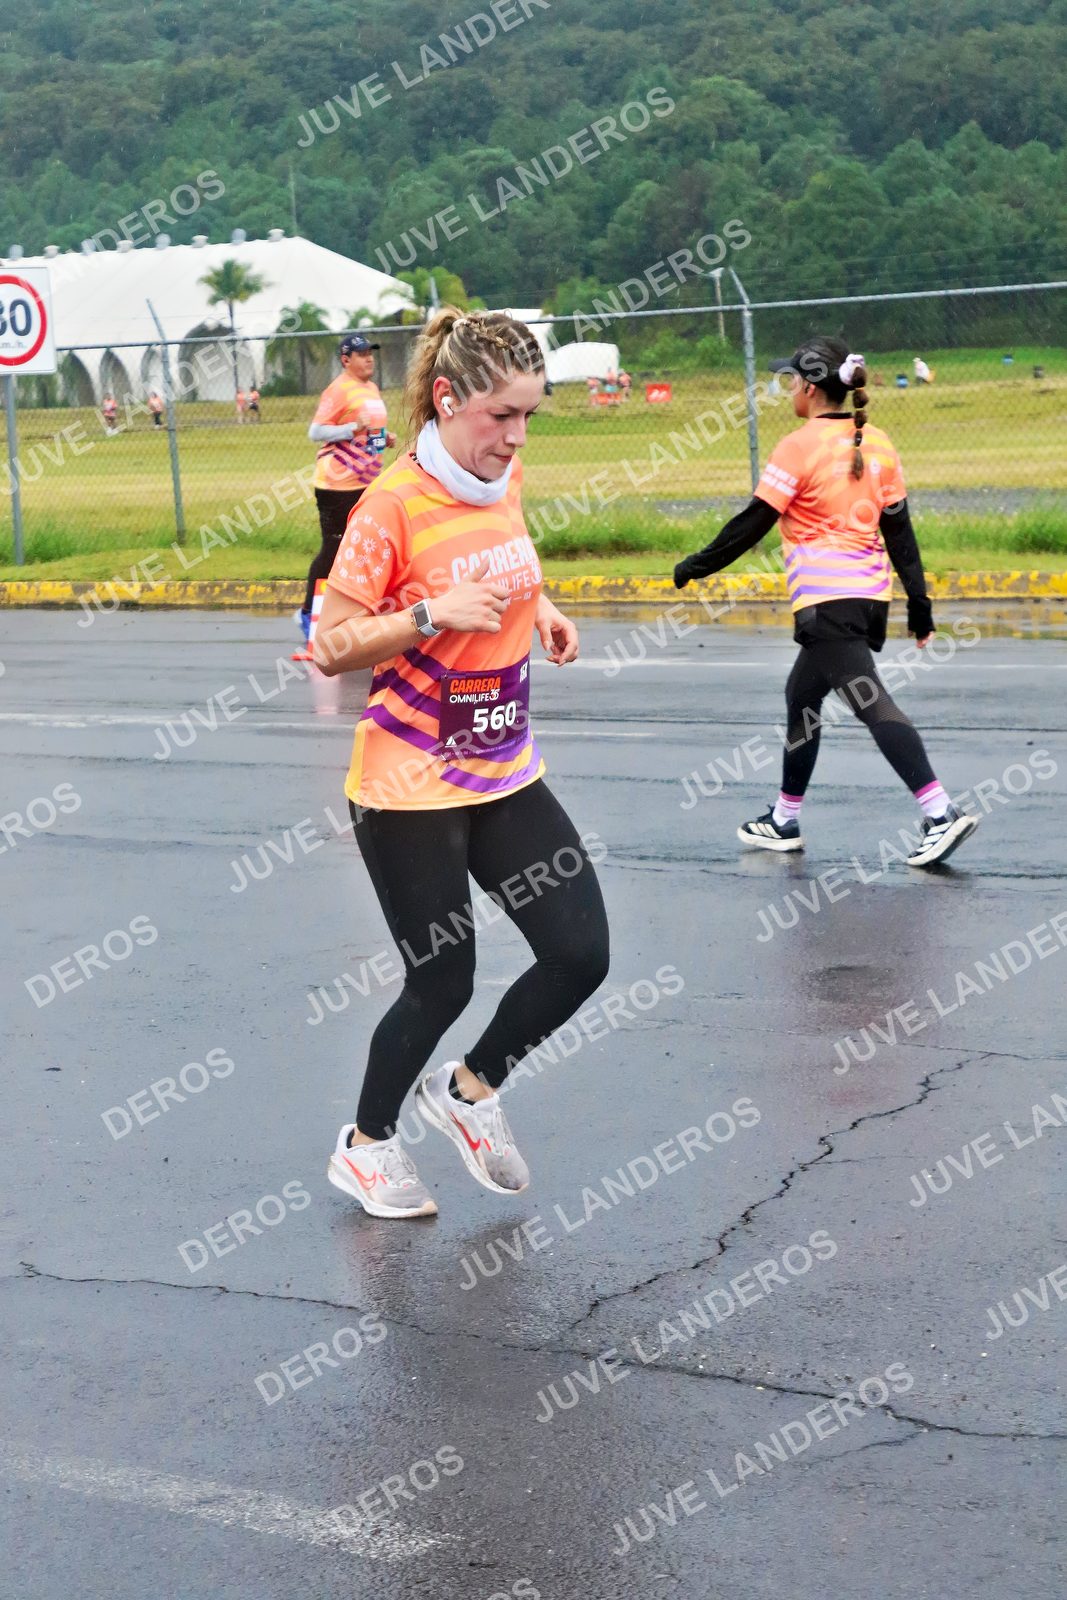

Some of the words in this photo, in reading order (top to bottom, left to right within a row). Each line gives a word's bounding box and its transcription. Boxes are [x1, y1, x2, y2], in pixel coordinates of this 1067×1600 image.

[449, 675, 501, 693] CARRERA
[449, 692, 489, 704] OMNILIFE
[472, 701, 516, 733] 560
